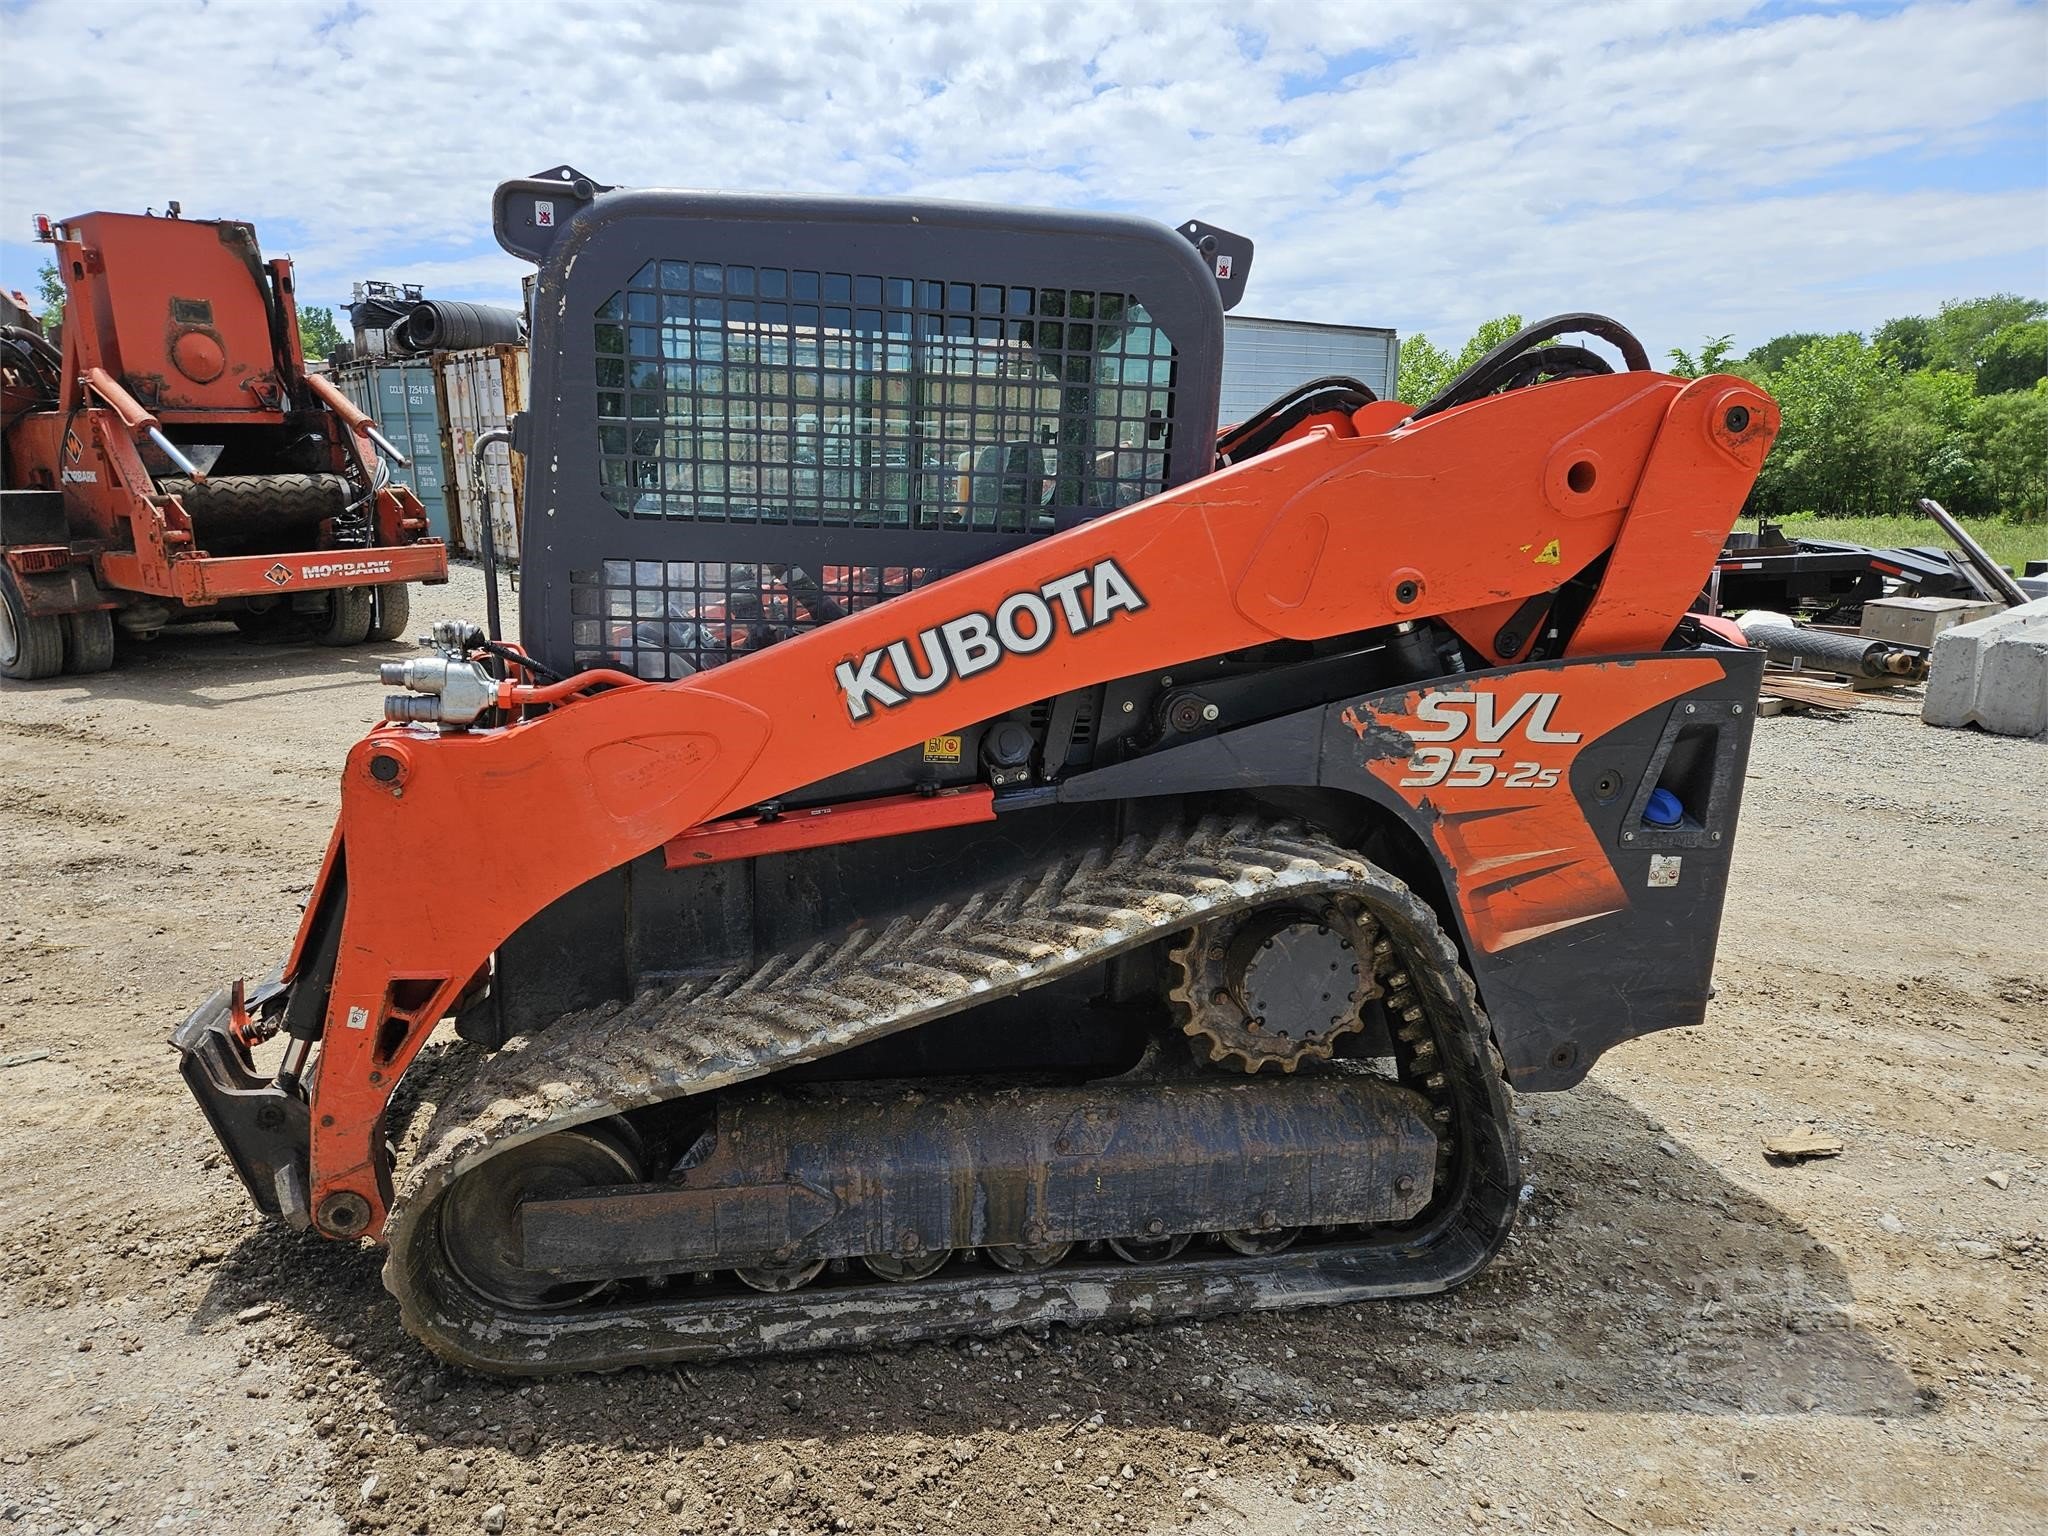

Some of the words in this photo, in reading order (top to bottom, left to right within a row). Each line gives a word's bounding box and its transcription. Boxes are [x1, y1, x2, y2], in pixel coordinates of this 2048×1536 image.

[408, 385, 429, 395] 725416
[302, 560, 391, 580] MORBARK
[835, 559, 1147, 720] KUBOTA
[1405, 691, 1583, 744] SVL
